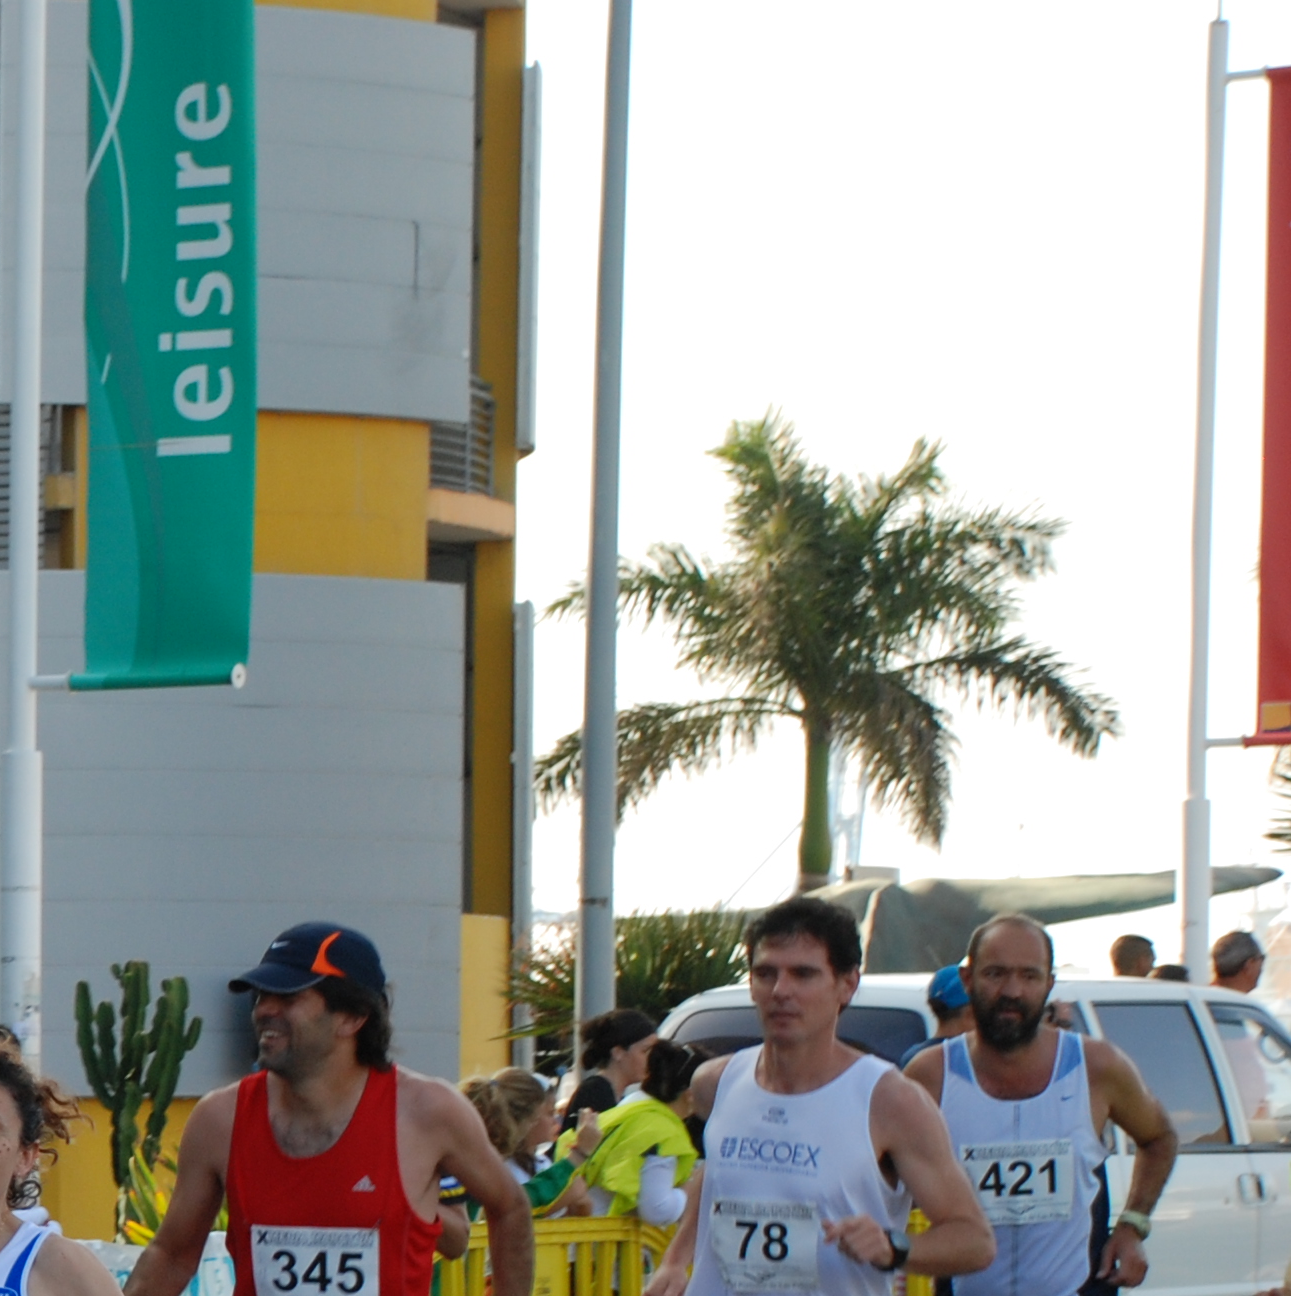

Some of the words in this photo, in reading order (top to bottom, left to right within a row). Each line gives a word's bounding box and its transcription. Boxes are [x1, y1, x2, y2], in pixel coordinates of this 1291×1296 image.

[156, 81, 234, 457] leisure
[738, 1137, 821, 1169] ESCOEX
[979, 1158, 1057, 1197] 421
[735, 1220, 789, 1262] 78
[272, 1249, 365, 1294] 345
